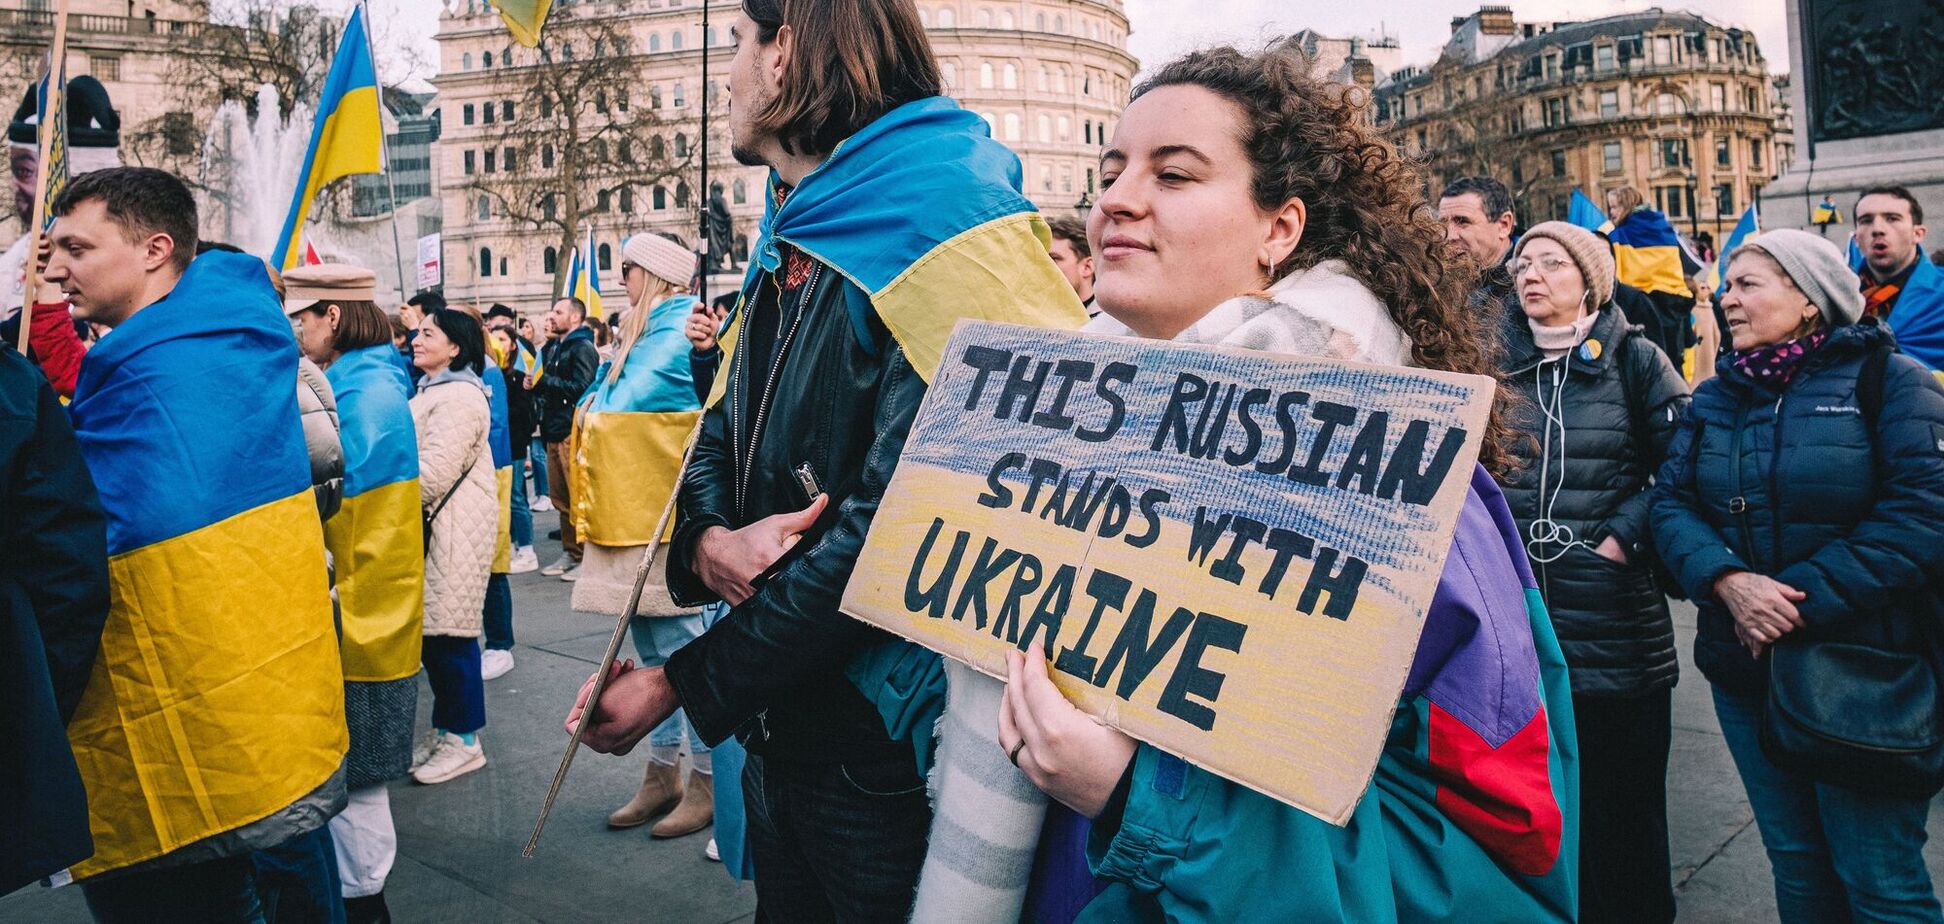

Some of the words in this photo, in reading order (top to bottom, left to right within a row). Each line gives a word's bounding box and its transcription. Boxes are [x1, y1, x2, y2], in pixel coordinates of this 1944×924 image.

[961, 346, 1138, 443] THIS
[1150, 371, 1467, 507] RUSSIAN
[977, 452, 1171, 549] STANDS
[1188, 505, 1369, 621] WITH
[903, 516, 1248, 732] UKRAINE
